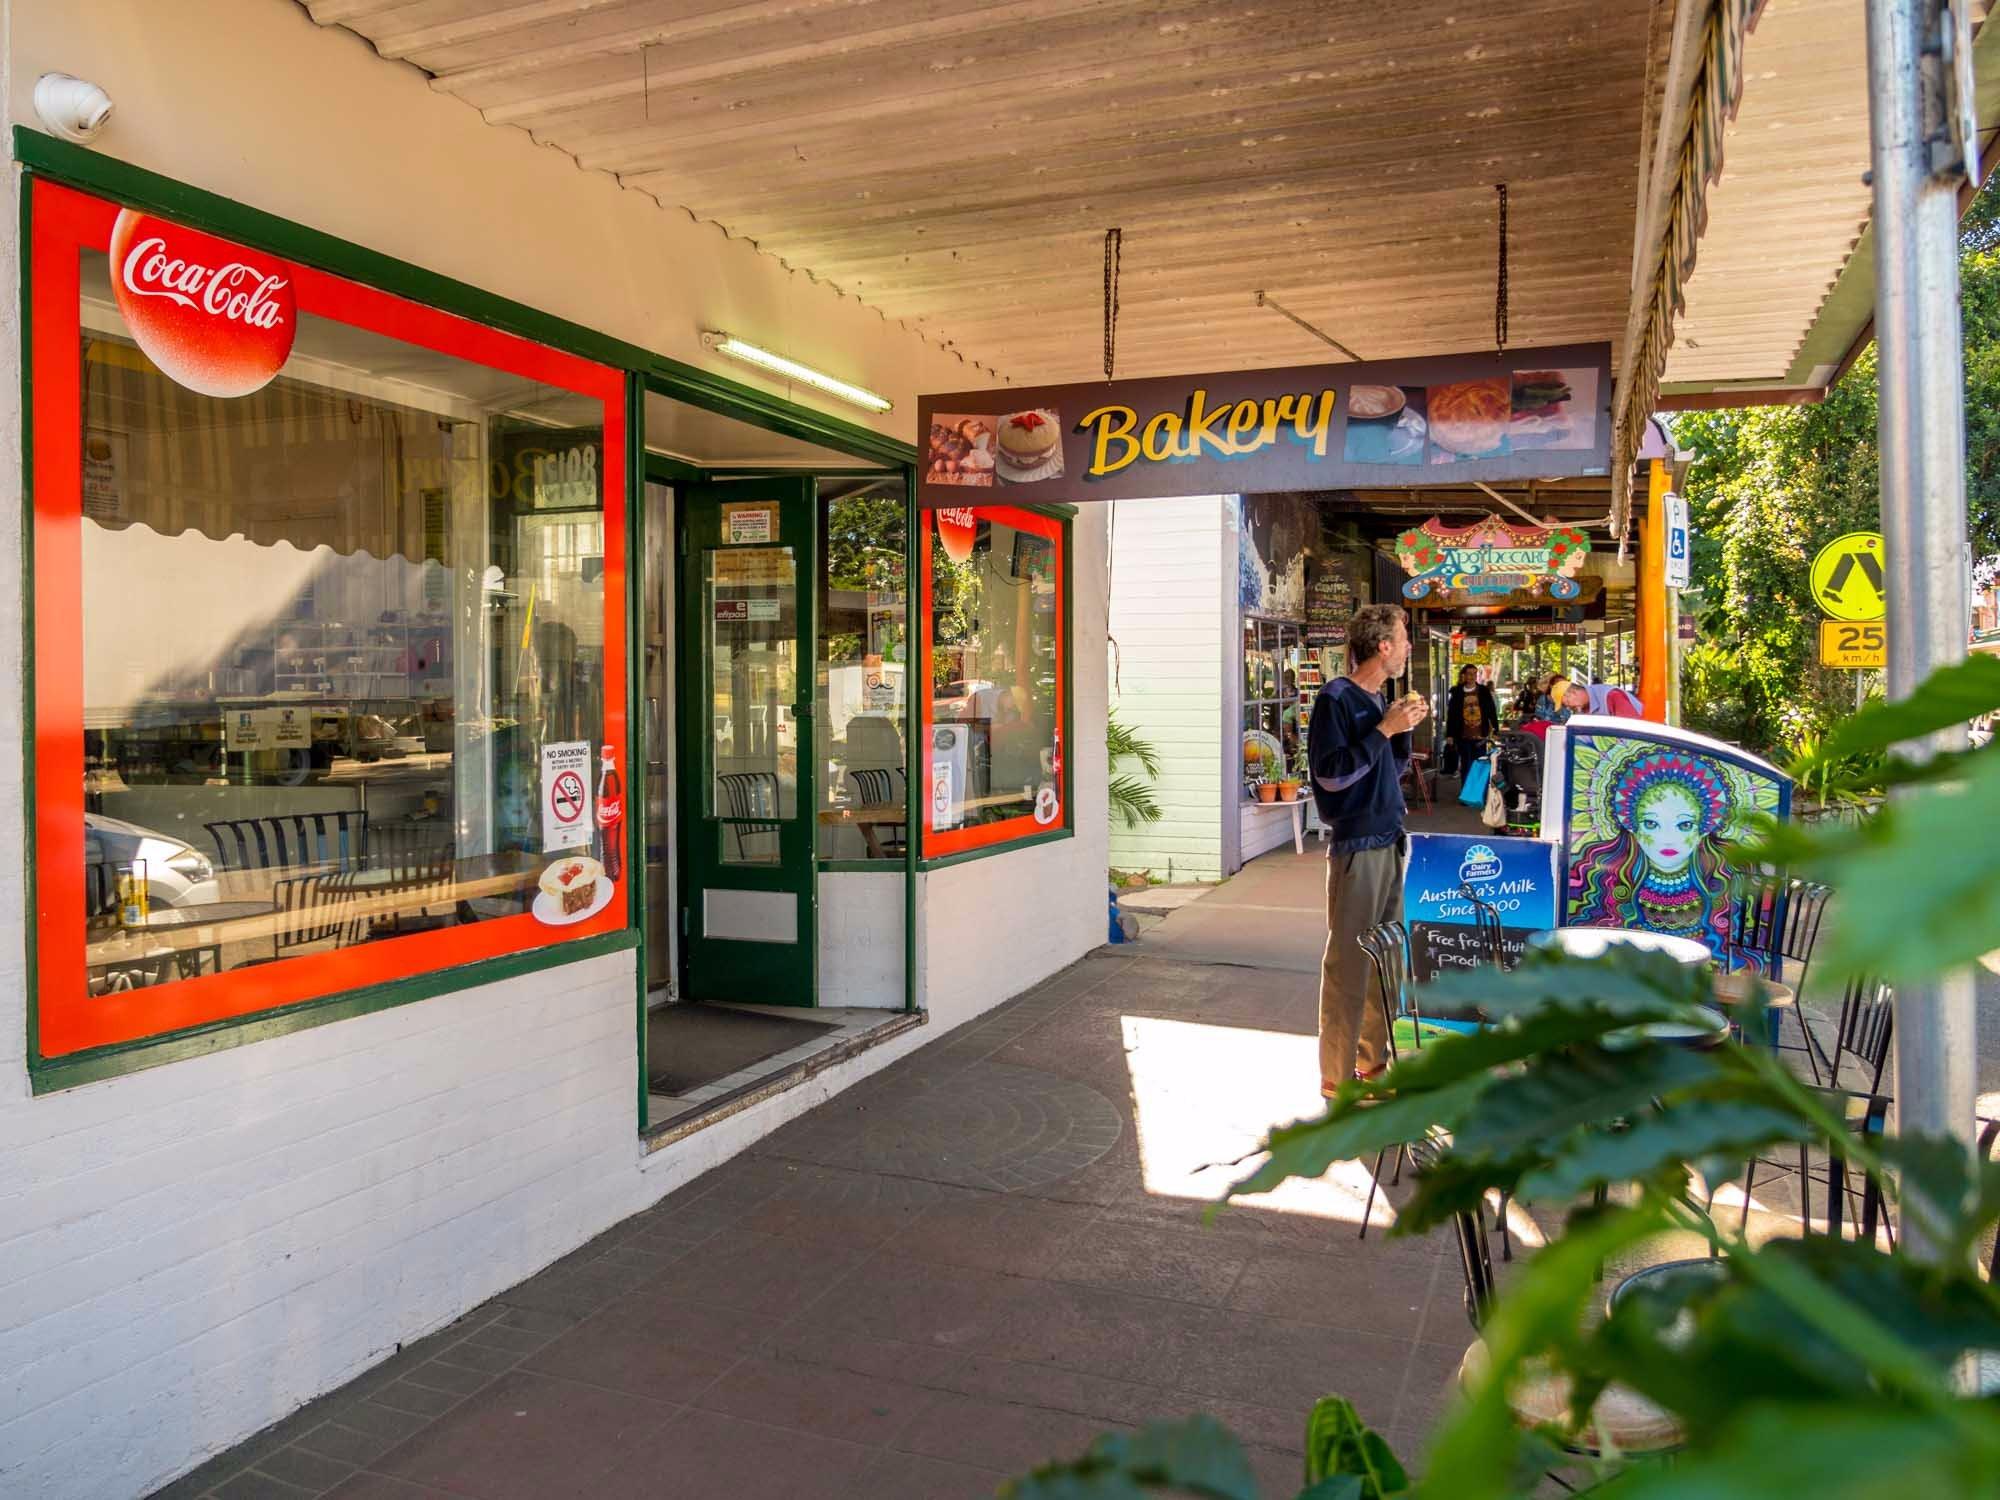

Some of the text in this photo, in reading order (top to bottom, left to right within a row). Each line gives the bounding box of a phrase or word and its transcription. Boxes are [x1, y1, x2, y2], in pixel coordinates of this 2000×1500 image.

[123, 237, 289, 330] Coca-Cola
[1082, 389, 1335, 479] Bakery
[1838, 627, 1884, 651] 25
[1842, 654, 1880, 663] km/h
[546, 748, 587, 759] NO SMOKING
[1466, 868, 1497, 879] Farmers
[1470, 863, 1492, 873] Dairy
[1499, 879, 1537, 896] Milk
[1438, 903, 1475, 919] Since
[1427, 930, 1455, 947] Free
